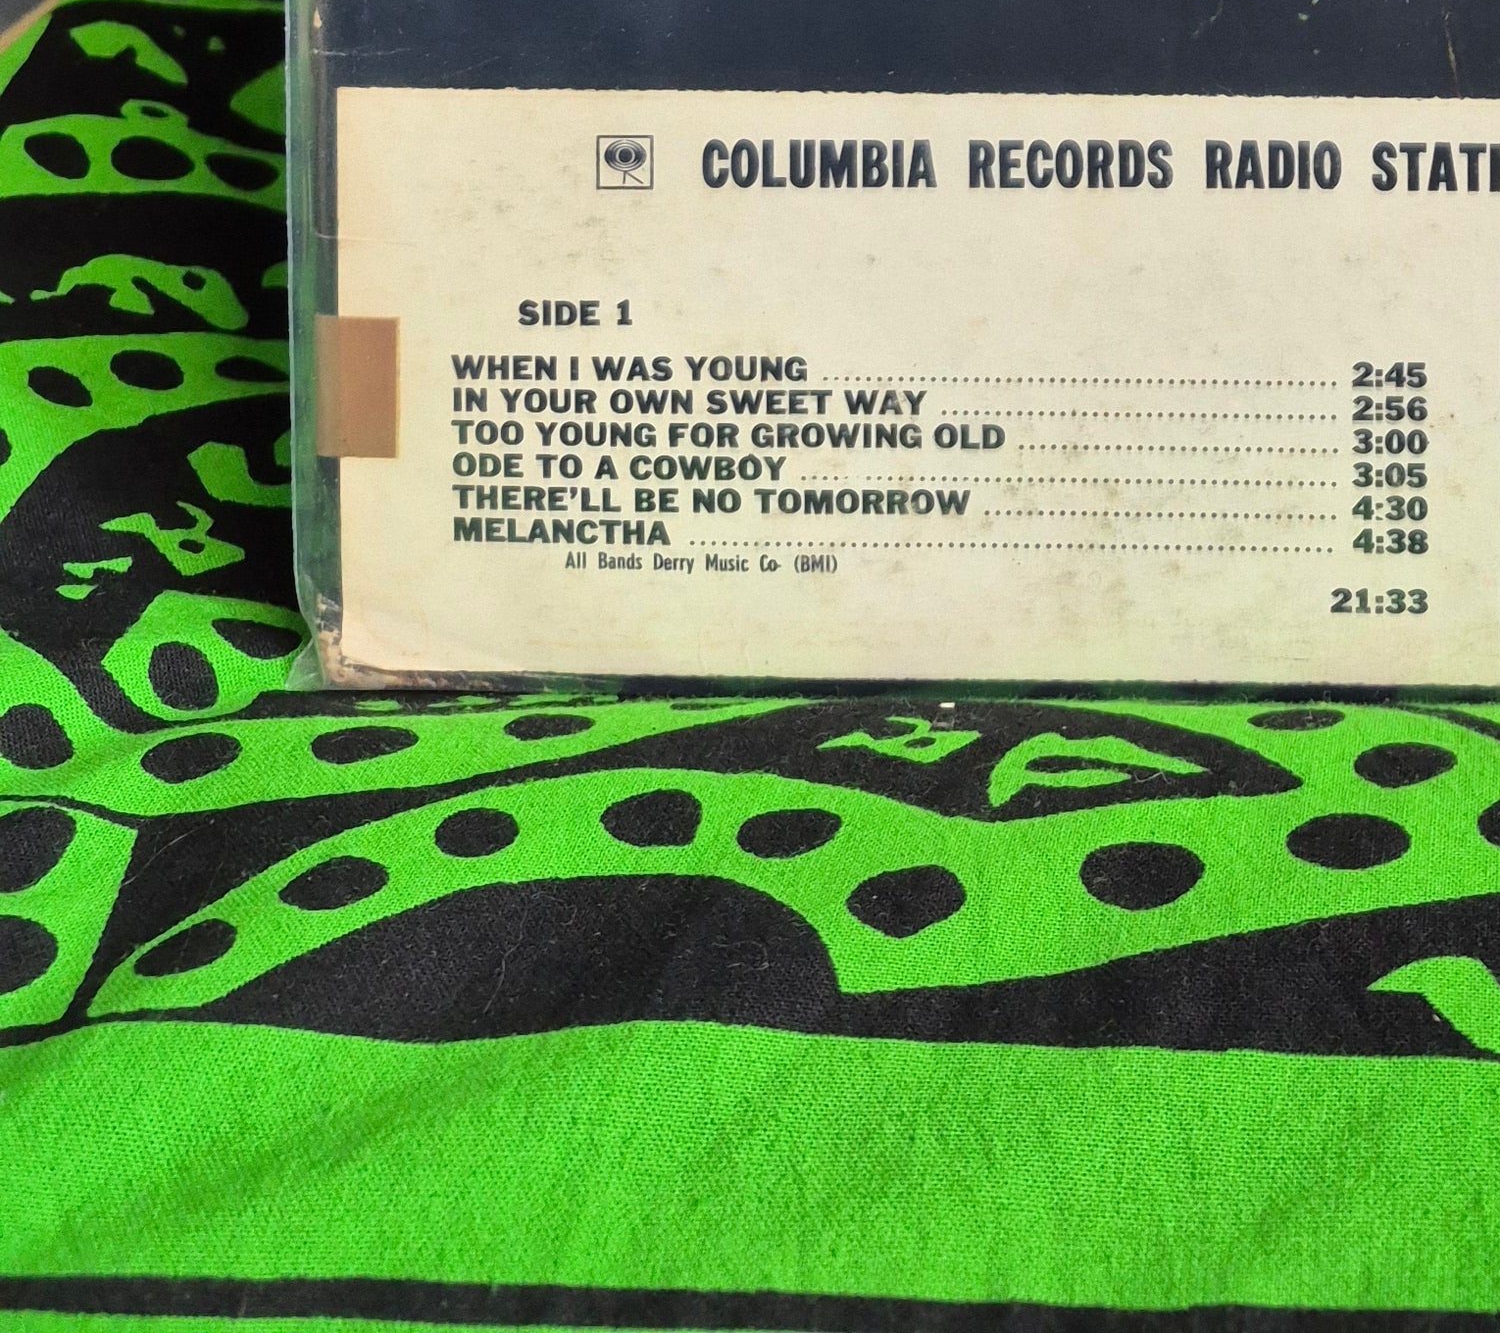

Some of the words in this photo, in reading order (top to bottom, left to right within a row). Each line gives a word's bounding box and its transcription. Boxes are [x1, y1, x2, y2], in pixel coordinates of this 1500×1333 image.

[701, 138, 938, 190] COLUMBIA
[968, 139, 1173, 190] RECORDS
[1205, 139, 1342, 191] RADIO
[518, 299, 601, 327] SIDE
[616, 299, 633, 326] 1
[452, 355, 556, 380] WHEN
[570, 356, 579, 381] I
[592, 357, 672, 381] WAS
[685, 356, 807, 382] YOUNG
[1352, 361, 1427, 388] 2:45
[453, 388, 488, 413] IN
[501, 389, 596, 413] YOUR
[610, 389, 692, 414] OWN
[707, 390, 832, 414] SWEET
[845, 390, 926, 415] WAY
[1352, 395, 1428, 421] 2:56
[452, 420, 523, 445] TOO
[536, 422, 656, 447] YOUNG
[669, 423, 739, 448] FOR
[751, 423, 921, 448] GROWING
[934, 424, 1005, 449] OLD
[1352, 428, 1428, 454] 3:00
[453, 452, 523, 477] ODE
[536, 454, 582, 478] TO
[595, 455, 618, 479] A
[630, 454, 786, 480] COWBOY
[1352, 462, 1428, 488] 3:05
[453, 485, 621, 512] THERE'LL
[635, 488, 678, 512] BE
[693, 489, 741, 513] NO
[754, 489, 970, 515] TOMORROW
[1352, 495, 1428, 521] 4:30
[453, 517, 671, 545] MELANCTHA
[1352, 528, 1429, 554] 4:38
[565, 552, 587, 569] All
[598, 552, 643, 570] Bands
[653, 553, 695, 574] Derry
[705, 553, 749, 572] Music
[794, 554, 838, 574] (BMI)
[1330, 588, 1428, 614] 21:33
